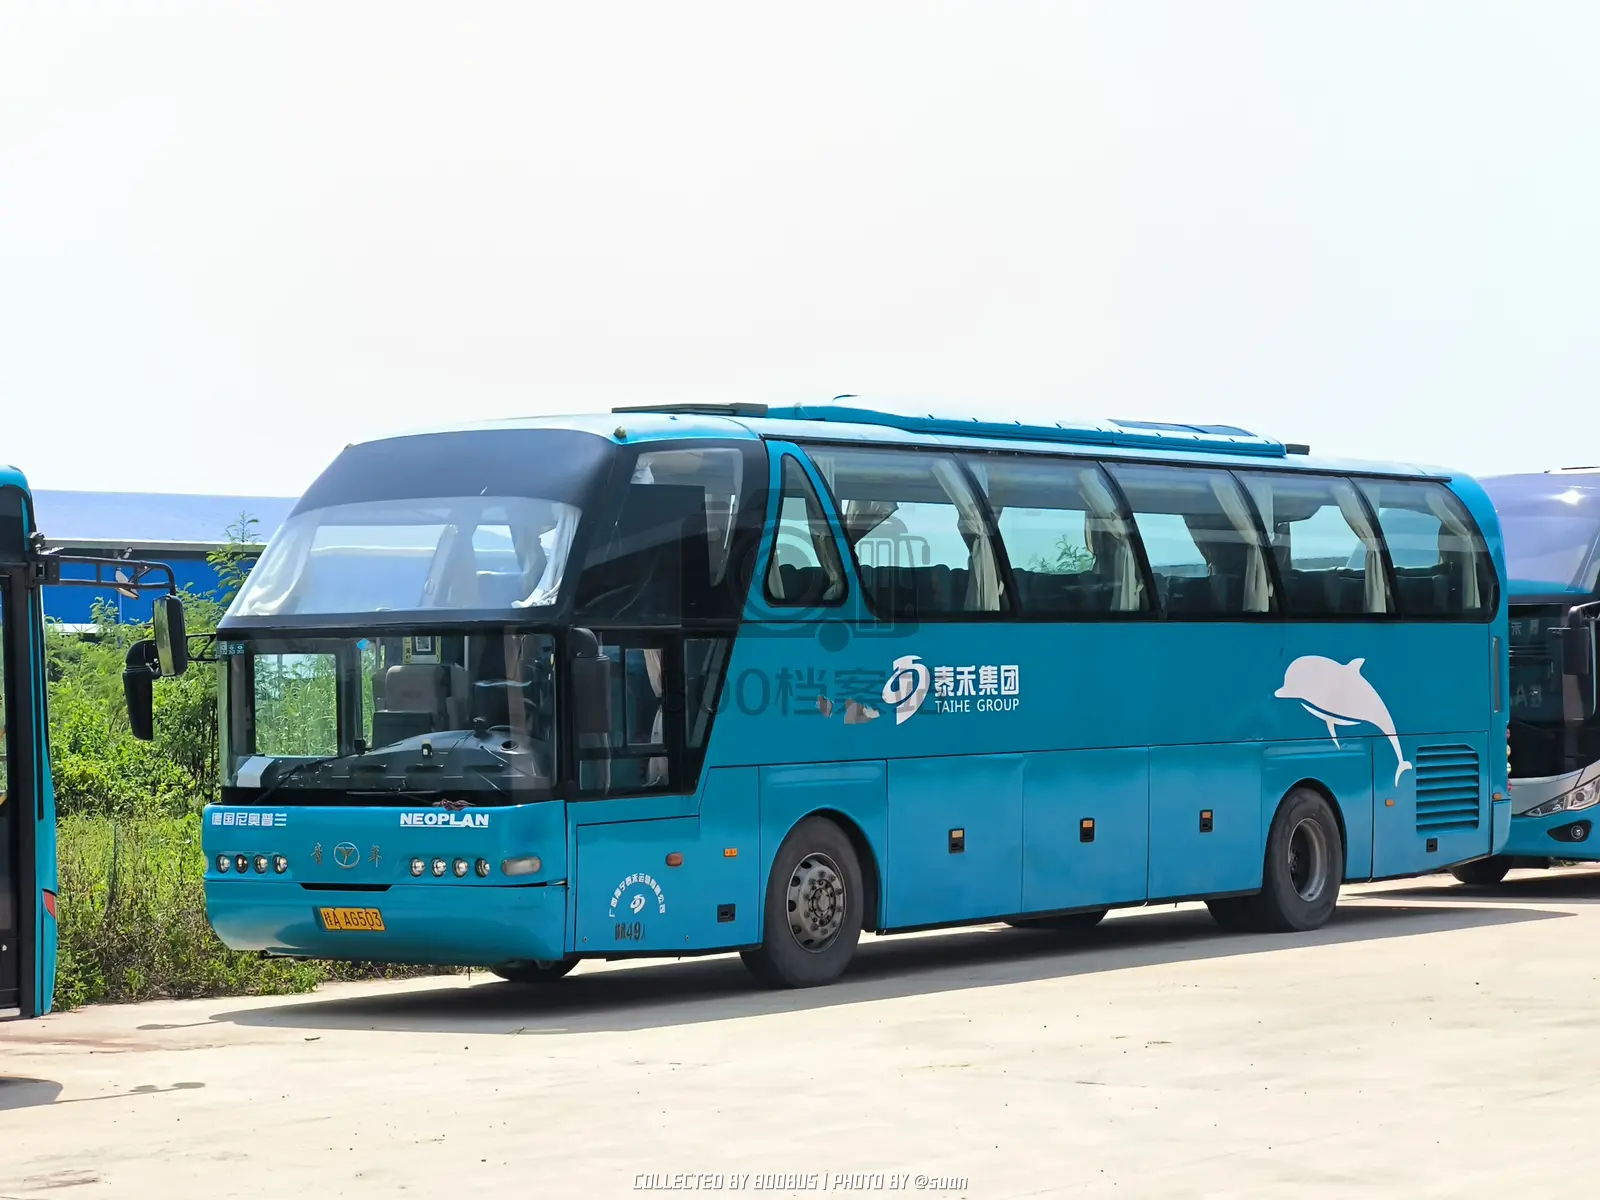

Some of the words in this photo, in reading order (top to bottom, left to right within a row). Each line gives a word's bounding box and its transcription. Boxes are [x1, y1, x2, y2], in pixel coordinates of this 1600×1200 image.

[934, 665, 1019, 697] 泰禾集团
[935, 699, 970, 713] TAIHE
[976, 698, 1020, 712] GROUP
[211, 811, 288, 827] 德国尼奥普兰
[400, 812, 489, 828] NEOPLAN
[343, 911, 382, 927] AG503
